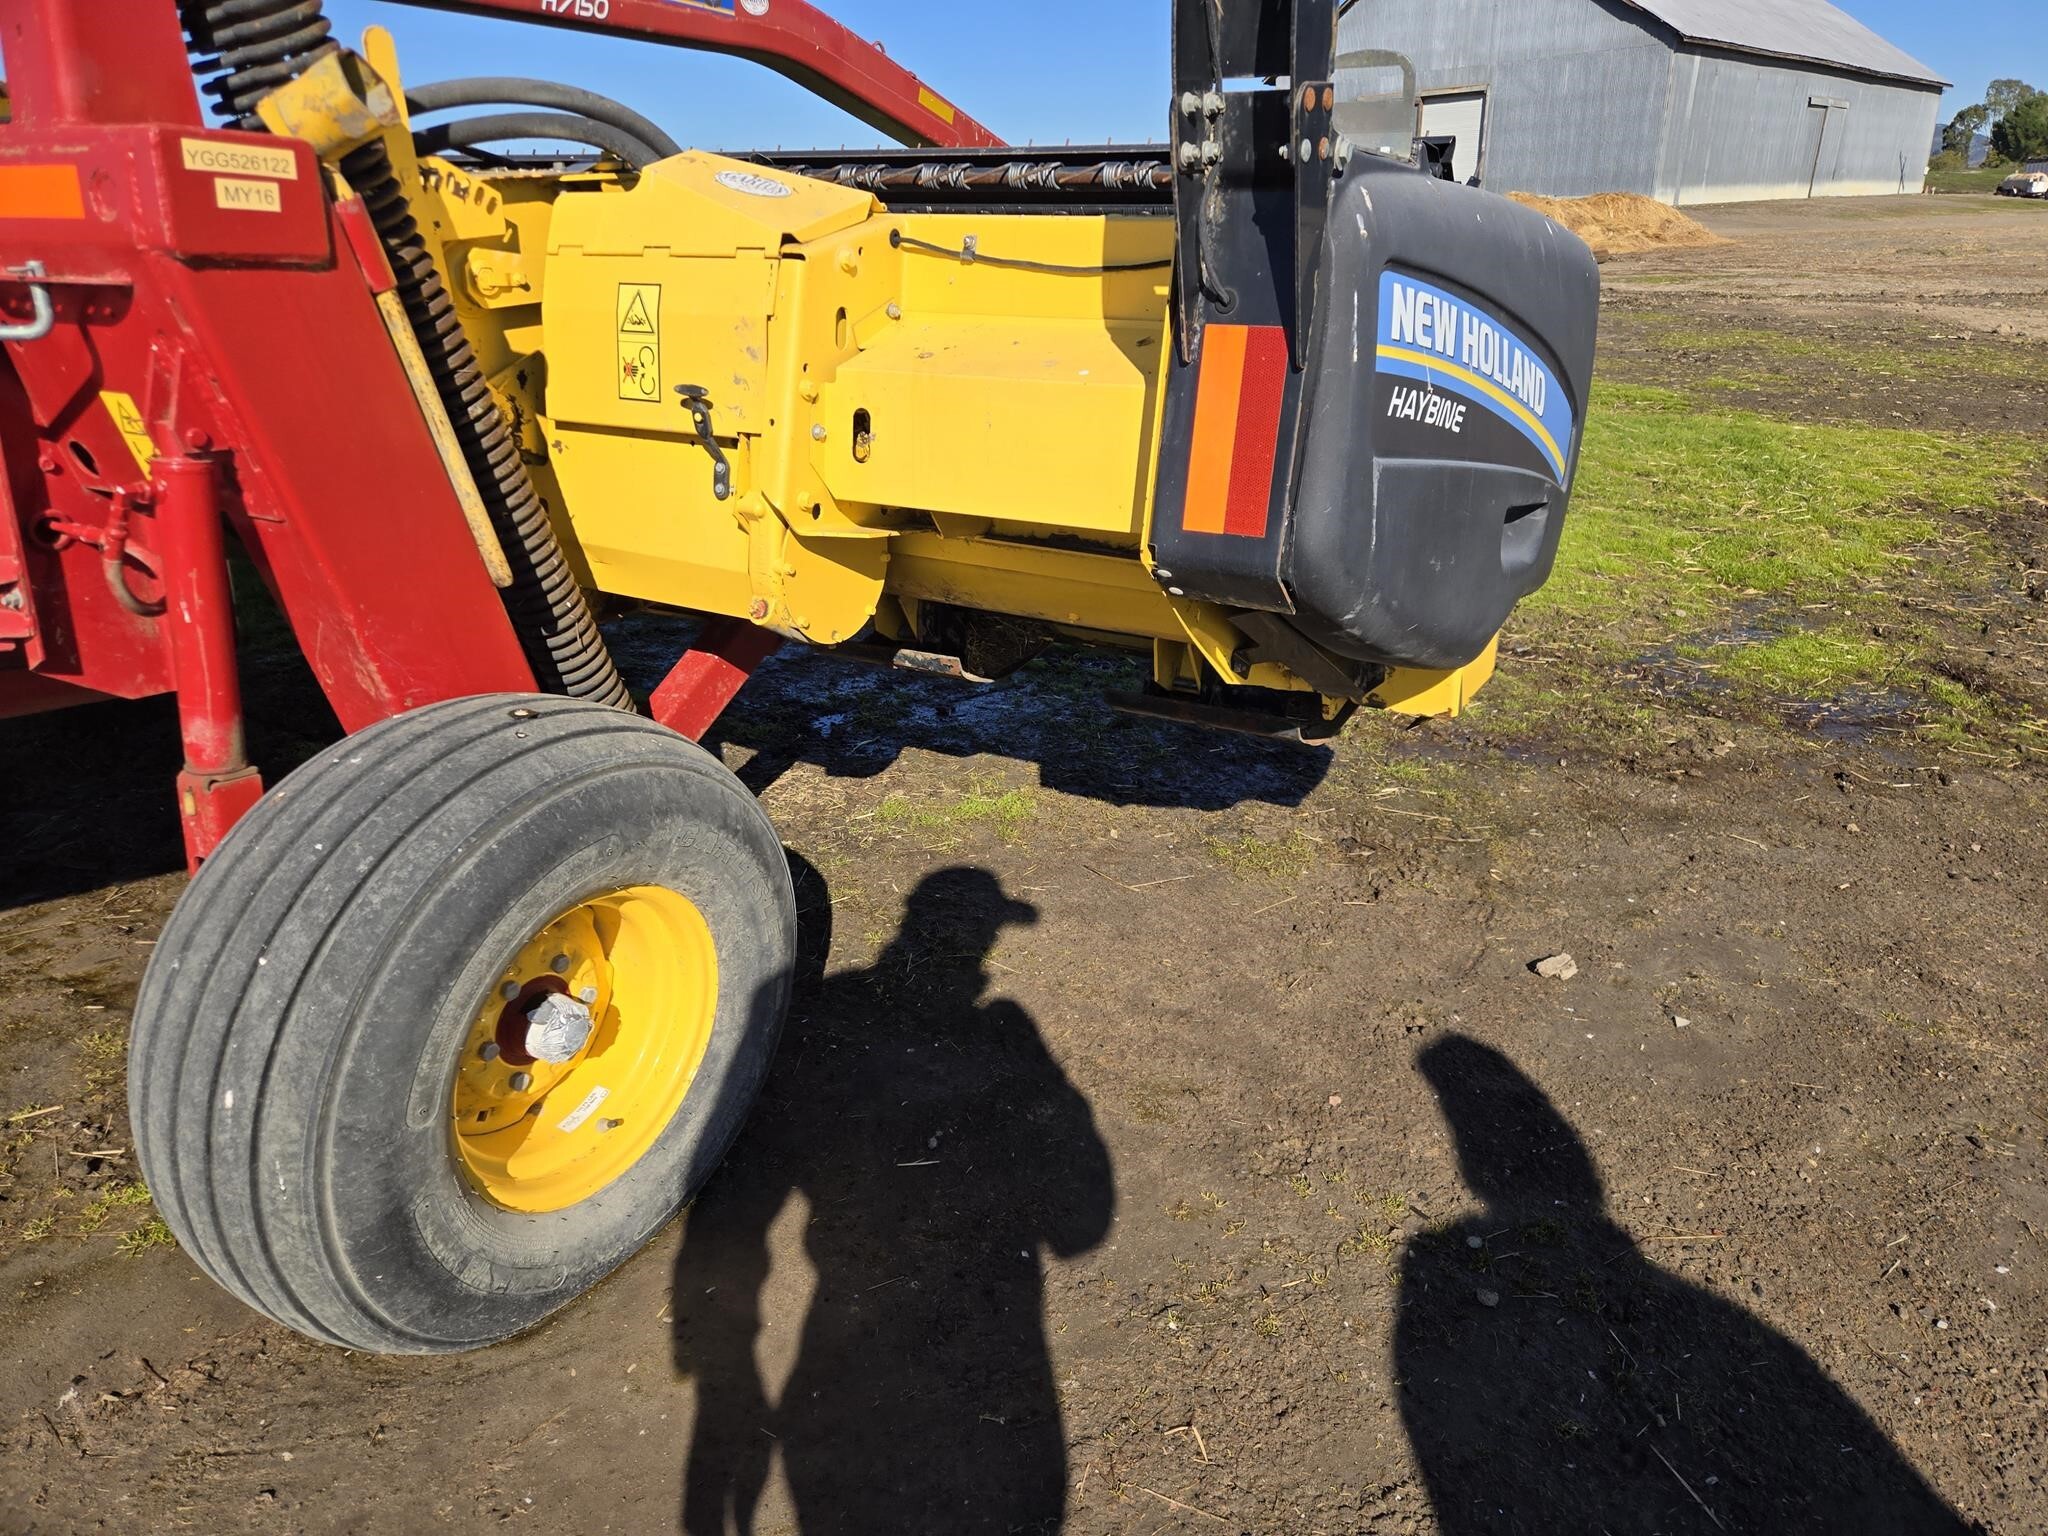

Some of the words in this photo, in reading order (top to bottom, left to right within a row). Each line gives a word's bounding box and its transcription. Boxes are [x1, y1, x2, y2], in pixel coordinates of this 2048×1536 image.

[187, 149, 290, 174] YGG526122
[223, 185, 275, 206] MY16
[1391, 283, 1457, 357] NEW
[1462, 309, 1546, 418] HOLLAND
[1387, 386, 1467, 434] HAYBINE
